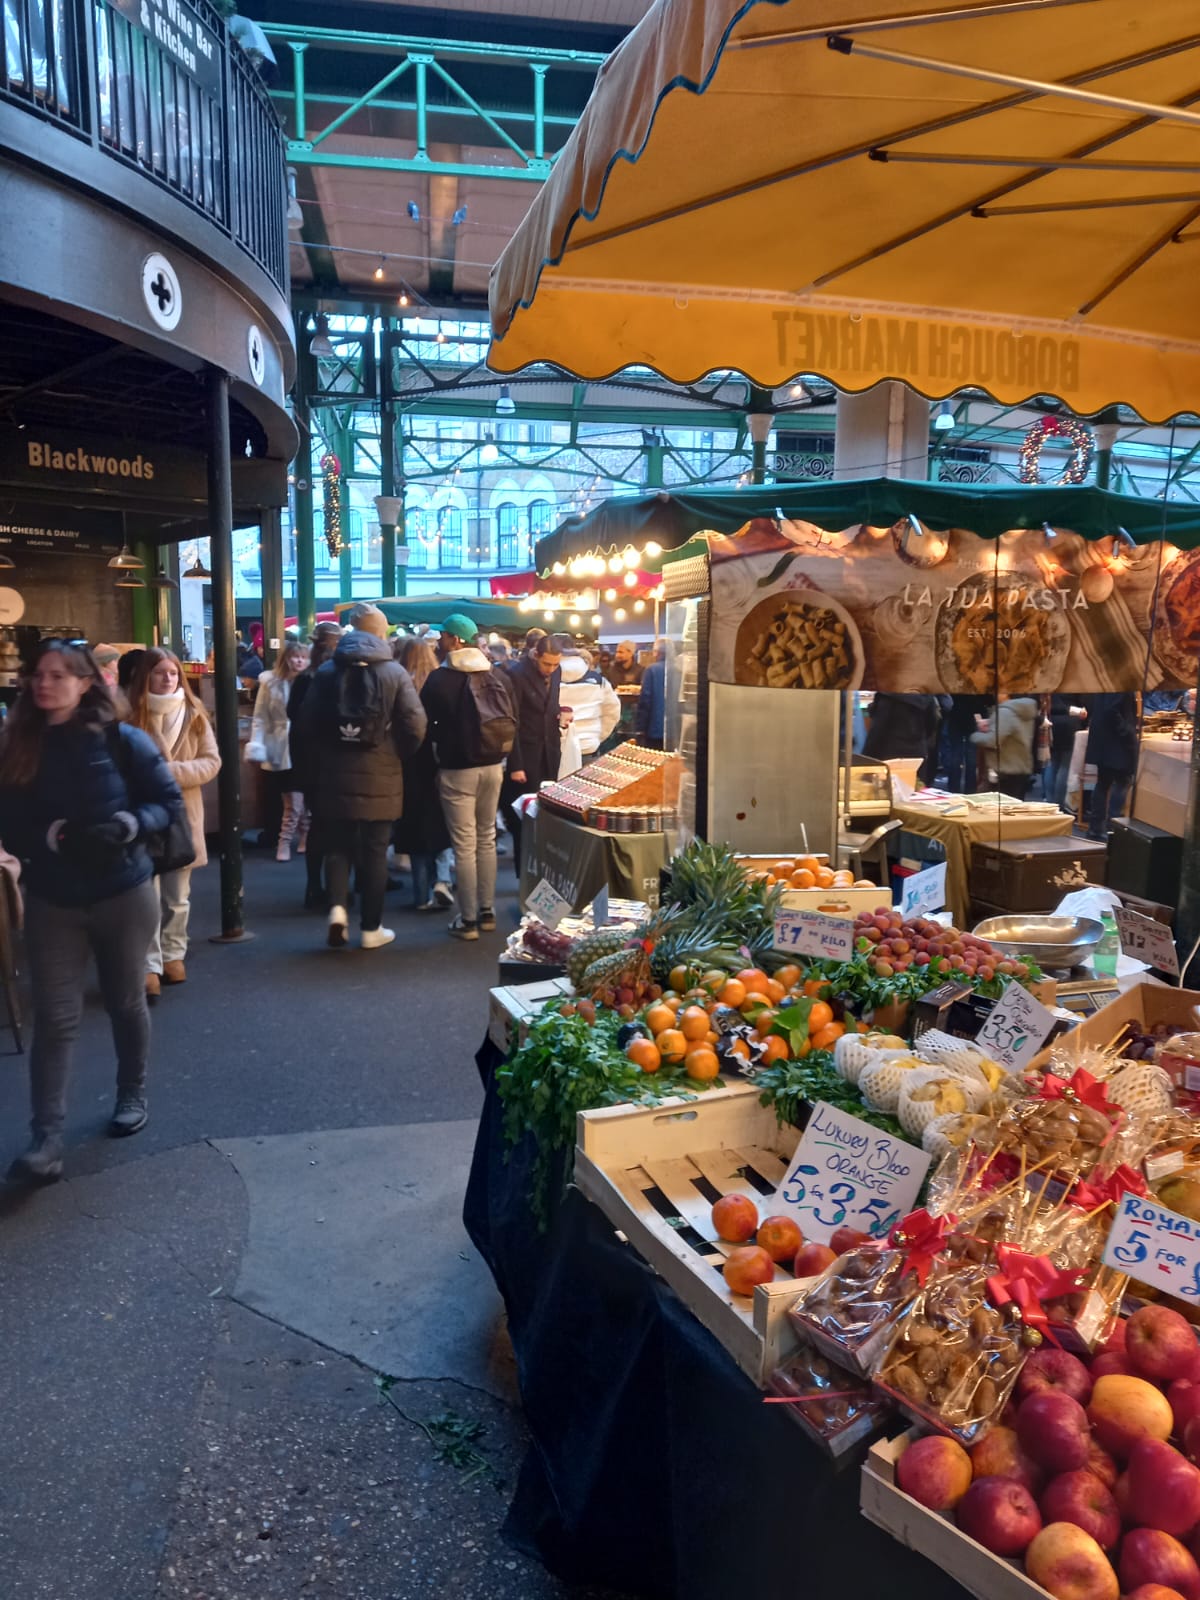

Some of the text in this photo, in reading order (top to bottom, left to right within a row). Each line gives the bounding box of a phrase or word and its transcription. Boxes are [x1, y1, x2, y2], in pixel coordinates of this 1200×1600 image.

[140, 0, 196, 73] & Kitchen
[167, 0, 212, 60] Wine Bar
[27, 441, 155, 480] Blackwoods
[11, 526, 45, 536] CHEESE
[54, 529, 80, 538] DAIRY
[903, 583, 1089, 610] LA TUA PASTA
[820, 934, 848, 948] KILO
[783, 1164, 820, 1204] 5
[826, 1153, 893, 1195] ORANGE
[1113, 1229, 1151, 1263] 5
[1155, 1248, 1187, 1267] FOR
